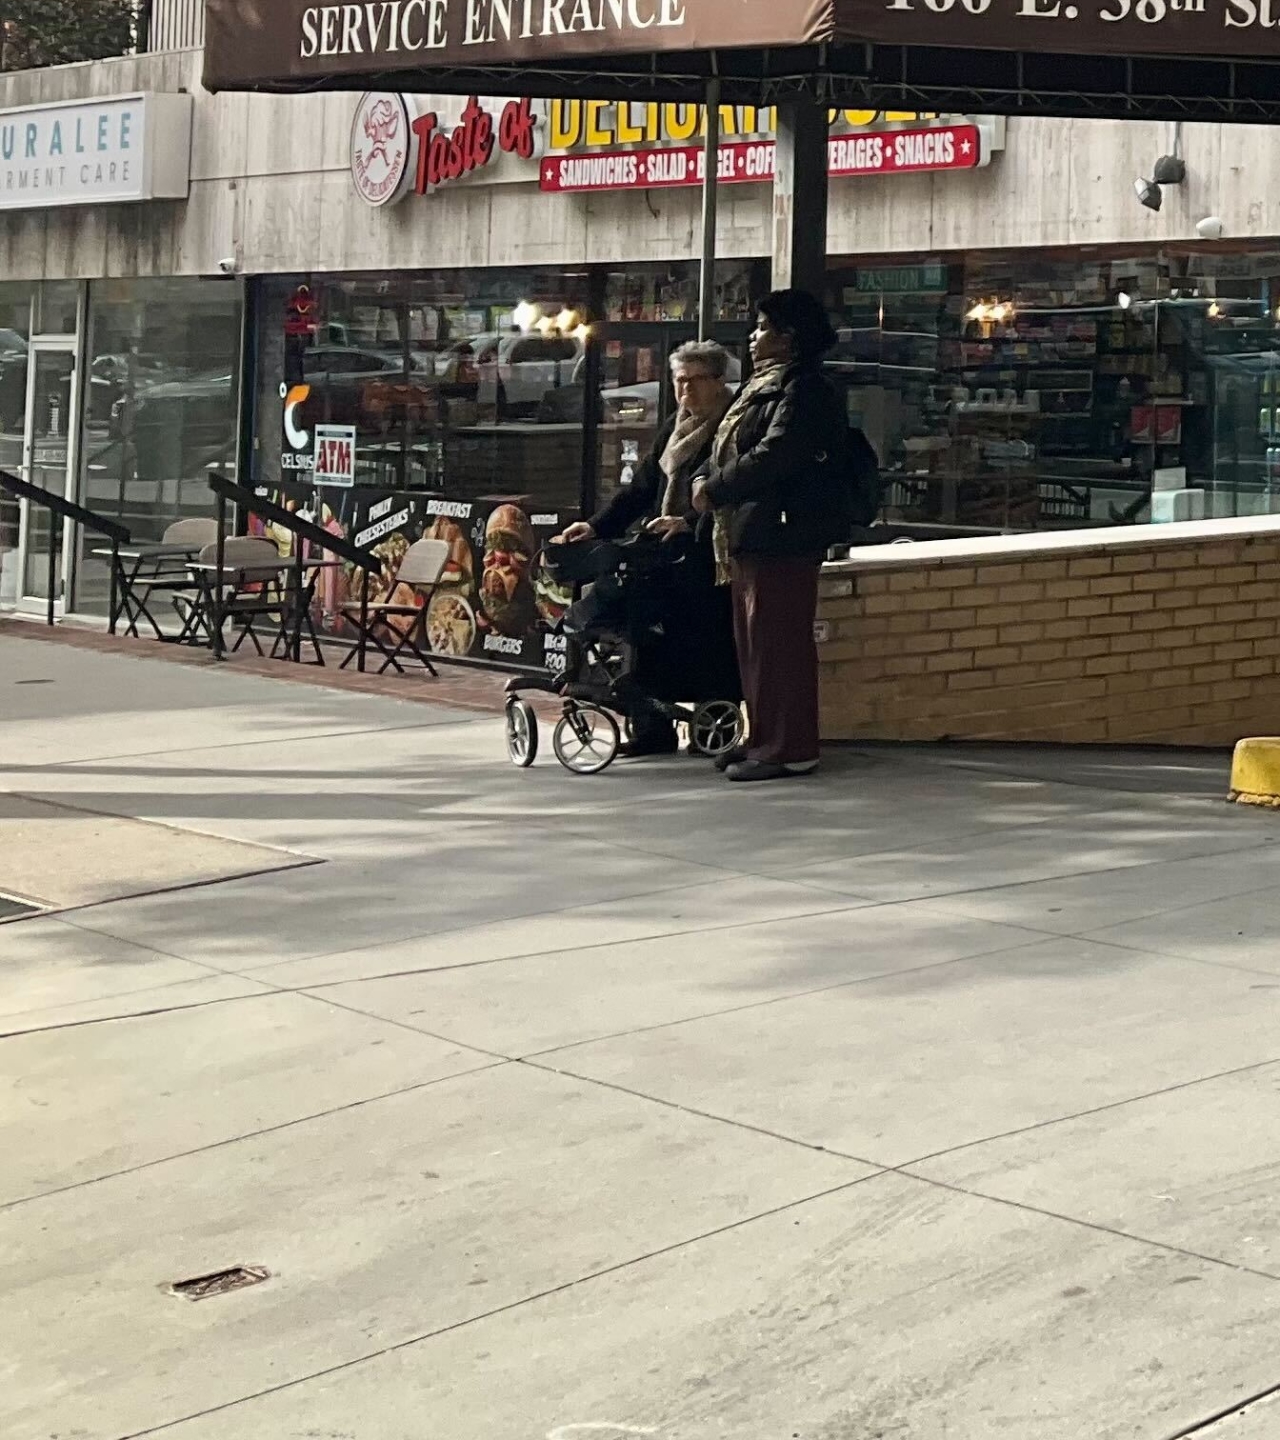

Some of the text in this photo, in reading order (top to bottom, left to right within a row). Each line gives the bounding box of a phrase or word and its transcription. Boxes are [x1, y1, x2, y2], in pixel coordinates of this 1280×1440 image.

[412, 94, 495, 196] Taste
[499, 97, 537, 159] of
[559, 156, 638, 187] SANDWICHES
[647, 153, 686, 182] SALAD
[697, 148, 735, 179] BGEL
[828, 138, 883, 170] ERAGES
[895, 132, 954, 166] SNACKS
[0, 160, 129, 191] RMENT CARE
[316, 440, 351, 474] ATM
[426, 500, 472, 518] BREAKFAST
[484, 634, 523, 655] BURGERS
[545, 652, 567, 671] FOO
